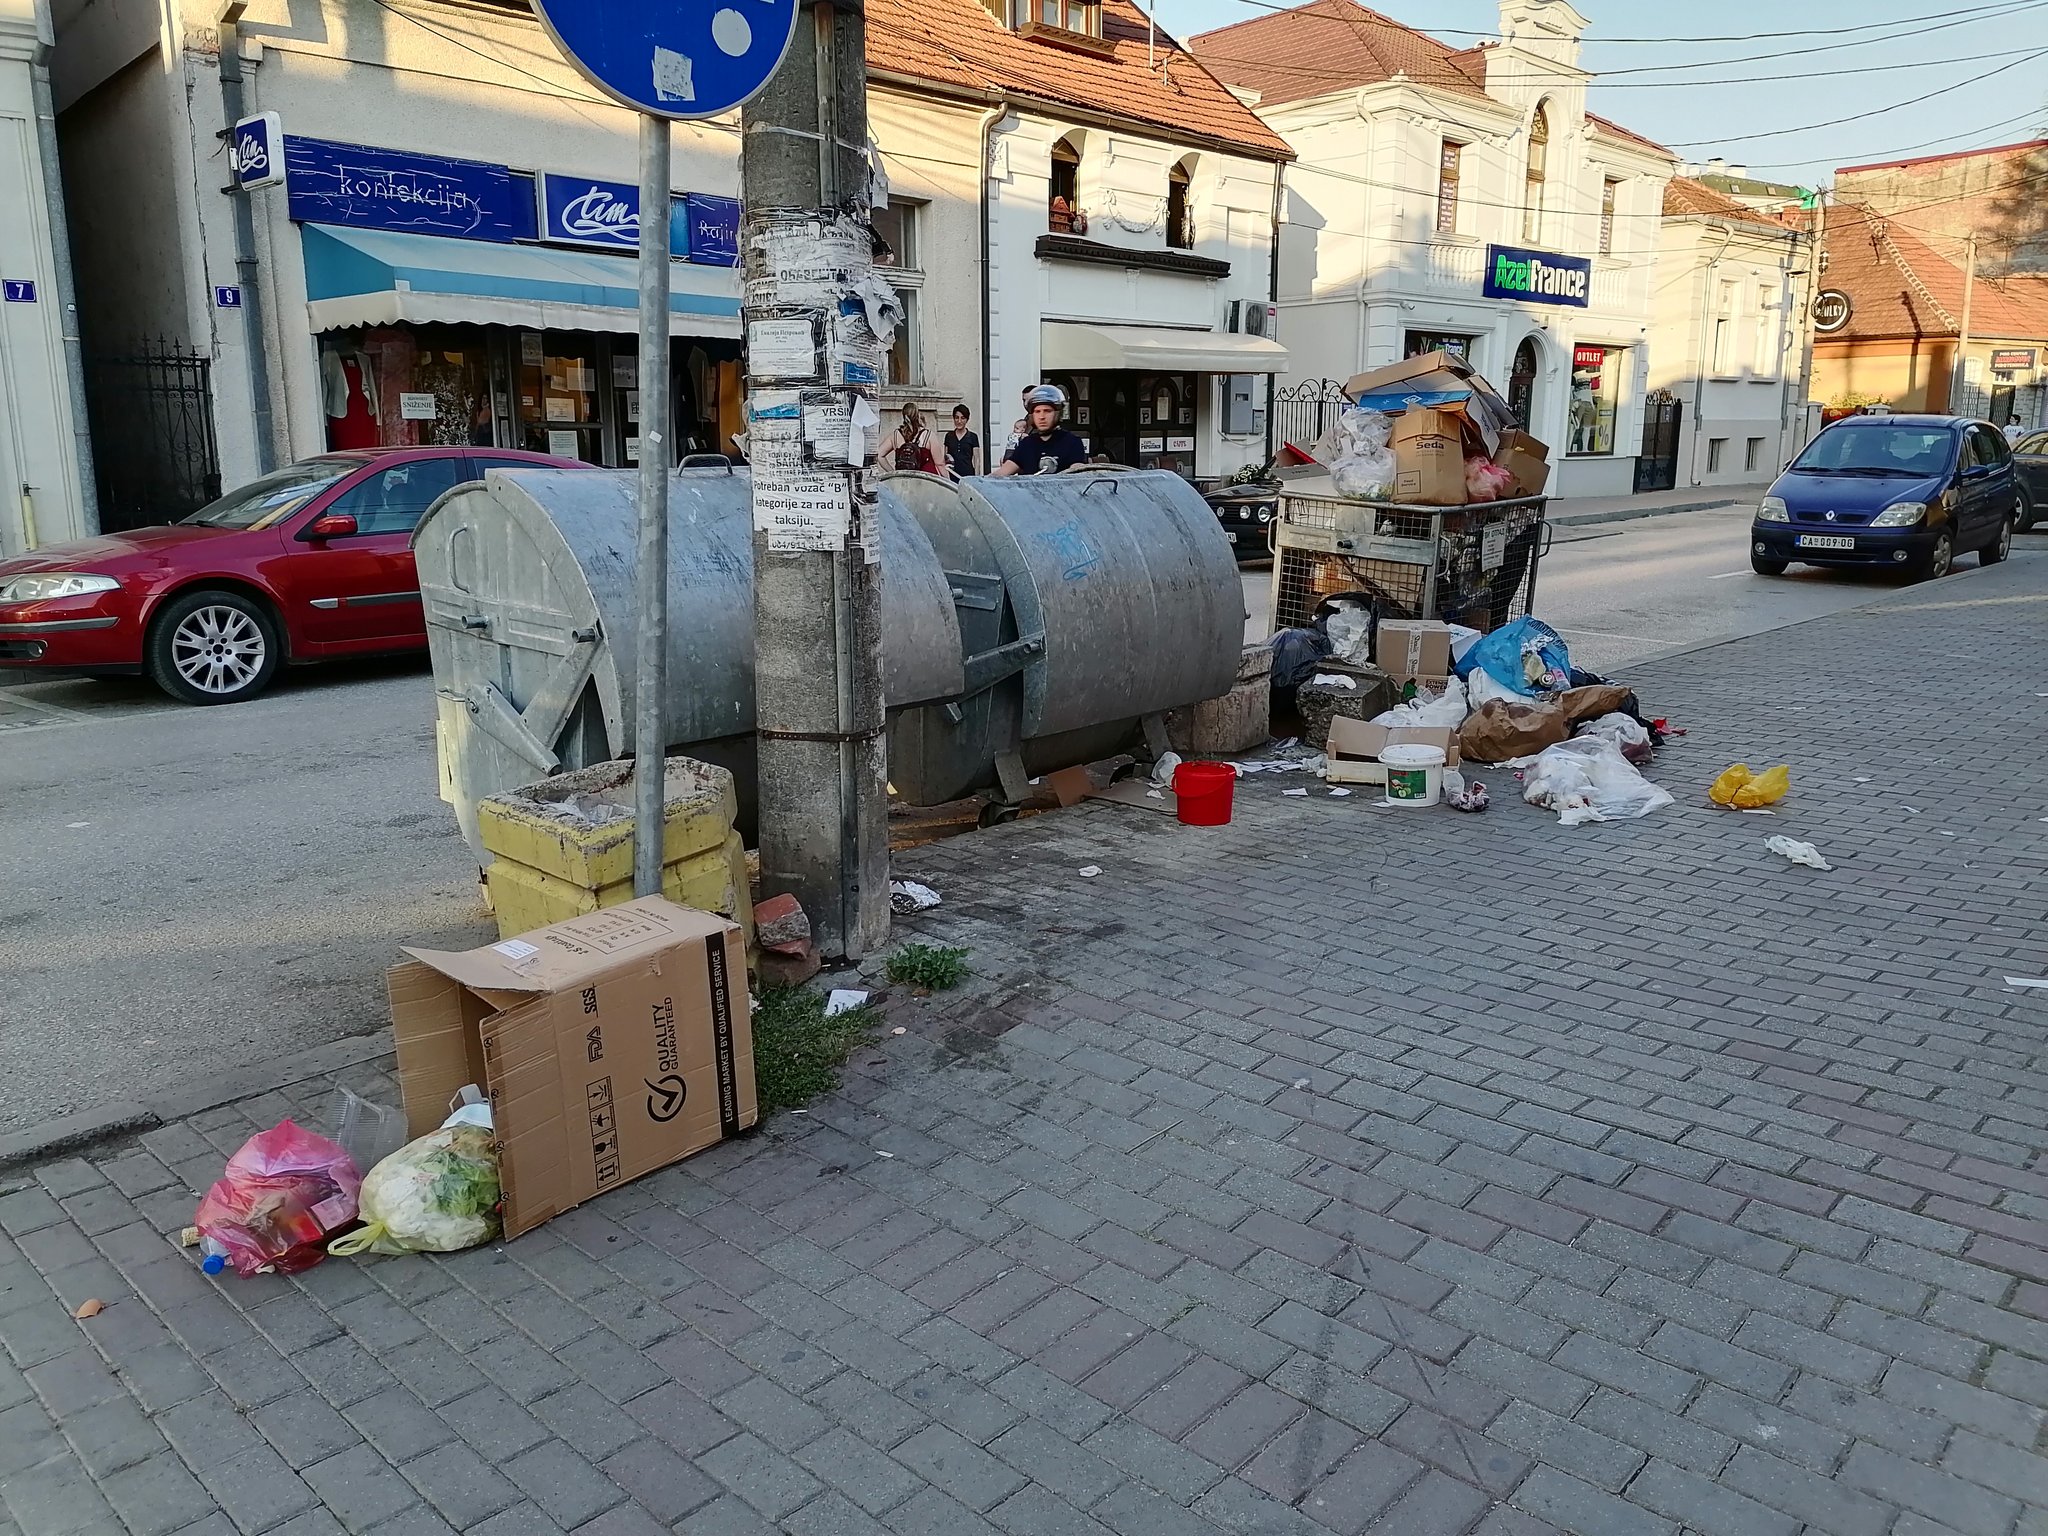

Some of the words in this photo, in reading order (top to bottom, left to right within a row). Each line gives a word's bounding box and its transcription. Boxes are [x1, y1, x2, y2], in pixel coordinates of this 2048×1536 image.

[562, 186, 639, 241] tim
[16, 284, 23, 298] 7
[227, 291, 233, 303] 9
[1577, 352, 1601, 362] OUTLET
[1416, 441, 1444, 449] Seda
[754, 482, 789, 492] Potreban
[794, 483, 824, 492] vozač
[755, 500, 798, 510] kategorije
[816, 500, 834, 509] rad
[775, 515, 814, 526] taksiju.
[712, 949, 722, 985] SERVICE
[584, 988, 597, 1014] SGS
[716, 989, 728, 1034] QUALIFIED
[587, 1026, 603, 1063] FDA
[652, 1004, 671, 1073] QUALITY
[663, 997, 680, 1070] GUARANTEED
[720, 1035, 729, 1047] BY
[721, 1049, 731, 1084] MARKET
[724, 1085, 733, 1122] LEADING
